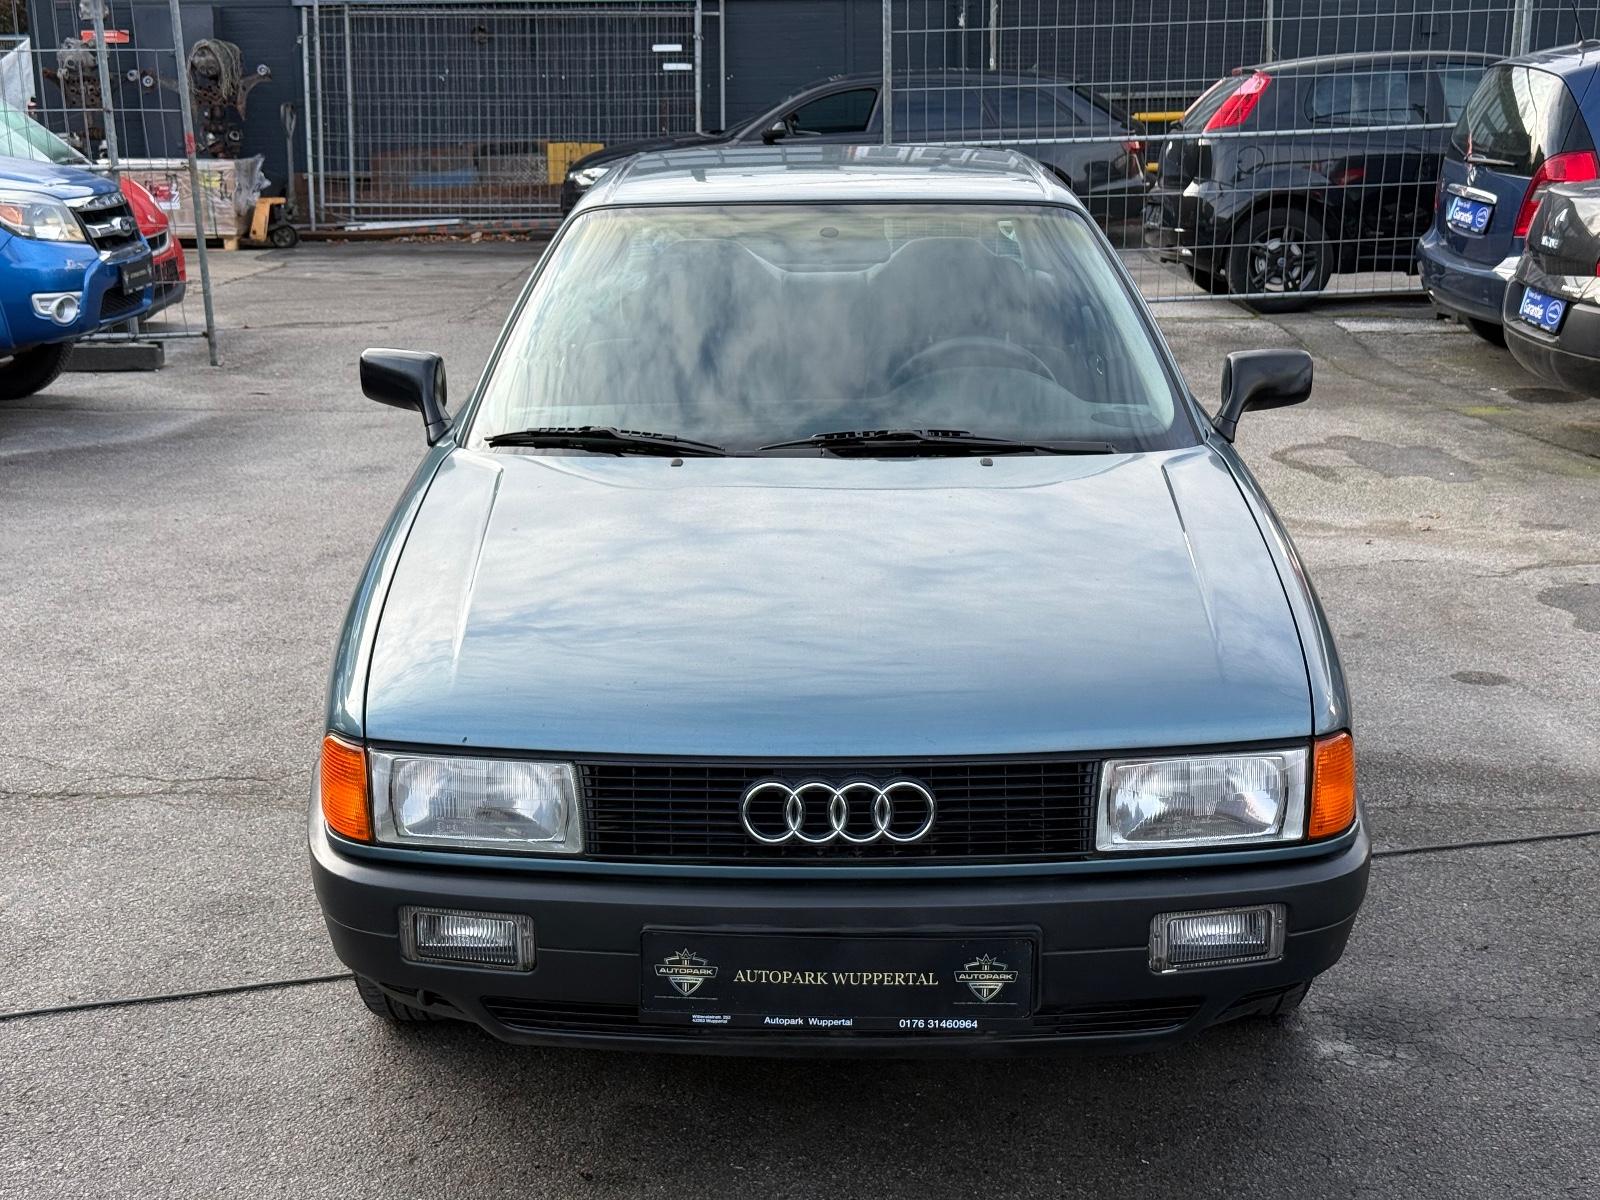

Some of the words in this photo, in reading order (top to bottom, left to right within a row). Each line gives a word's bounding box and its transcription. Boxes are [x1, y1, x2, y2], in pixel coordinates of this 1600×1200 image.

[658, 967, 714, 976] AUTOPARK
[733, 969, 829, 985] AUTOPARK
[831, 971, 939, 986] WUPPERTAL
[958, 973, 1014, 981] AUTOPARK
[764, 1016, 804, 1026] Autopark
[808, 1017, 853, 1027] Wuppertal
[899, 1019, 925, 1029] 0176
[927, 1019, 978, 1029] 31460964
